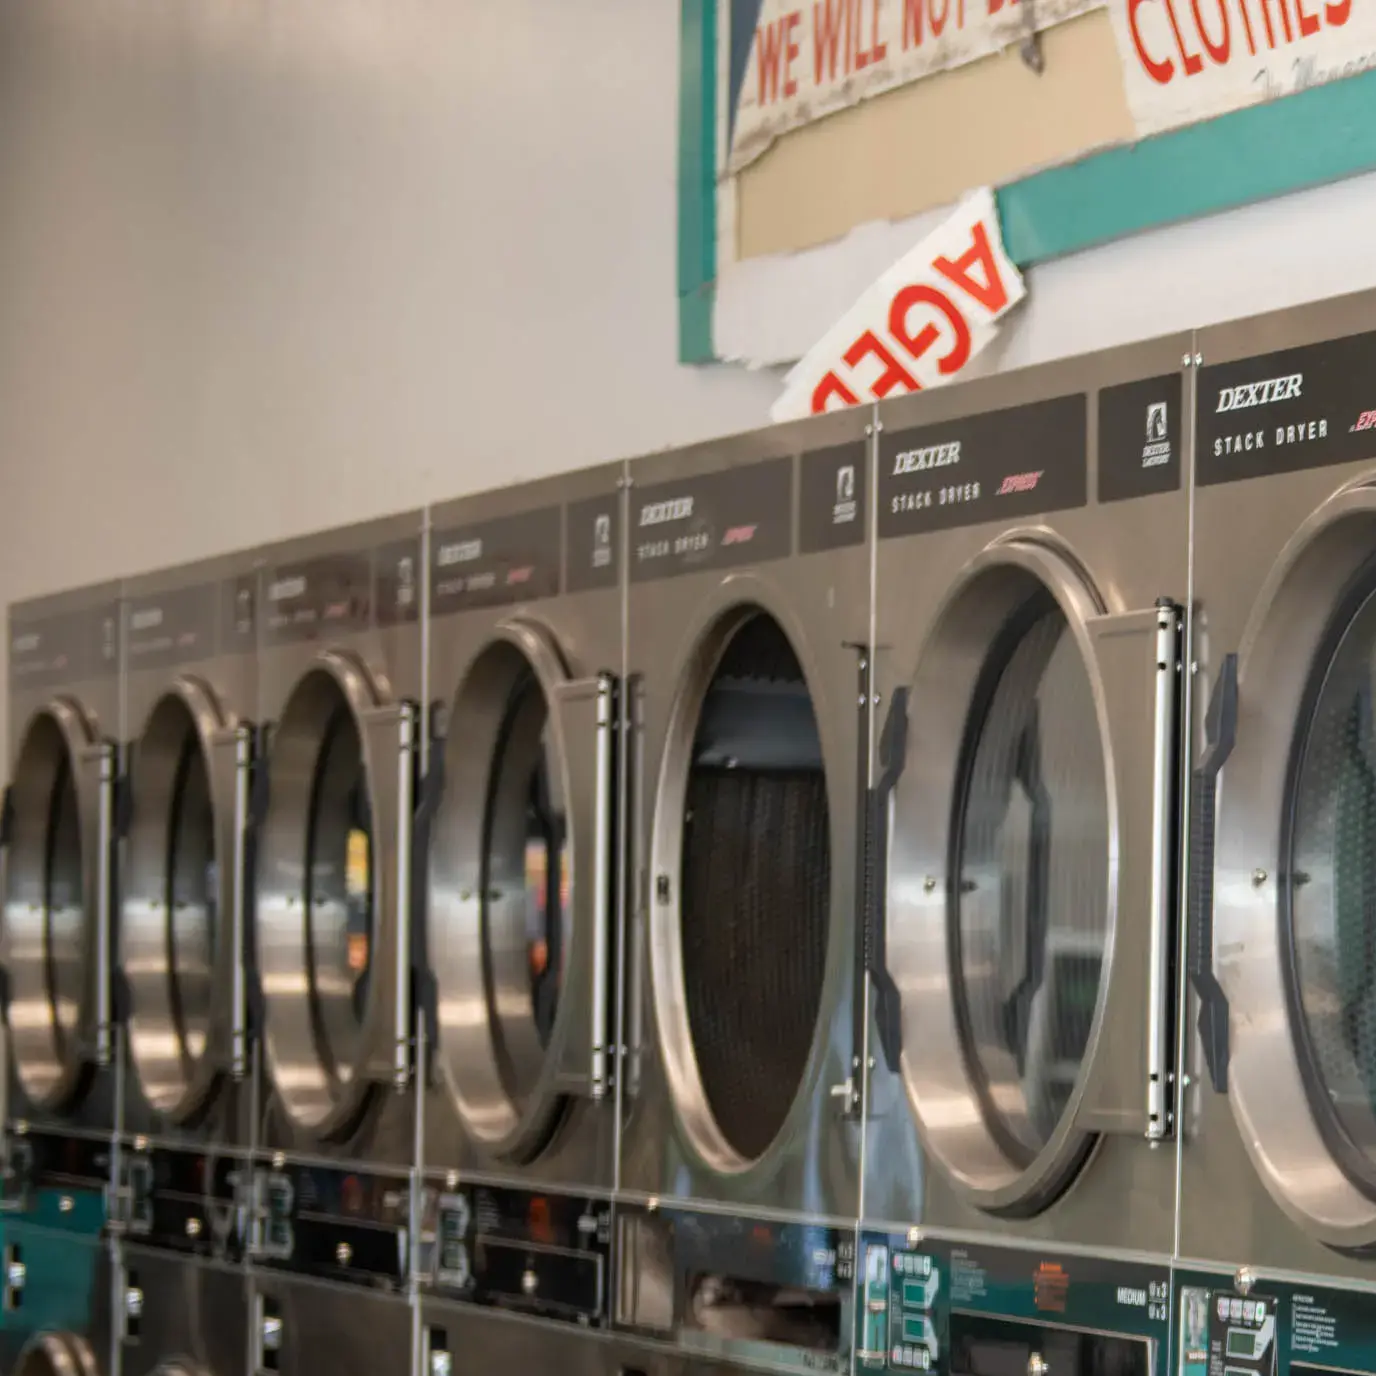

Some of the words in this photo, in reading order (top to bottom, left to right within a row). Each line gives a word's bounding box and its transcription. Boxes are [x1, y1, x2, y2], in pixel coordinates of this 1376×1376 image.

[757, 10, 801, 107] WE
[811, 0, 888, 86] WILL
[1215, 373, 1304, 414] DEXTER
[1214, 431, 1265, 457] STACK
[1275, 419, 1328, 446] DRYER
[892, 441, 962, 475] DEXTER
[892, 490, 932, 514] STACK
[938, 481, 981, 506] DRYER
